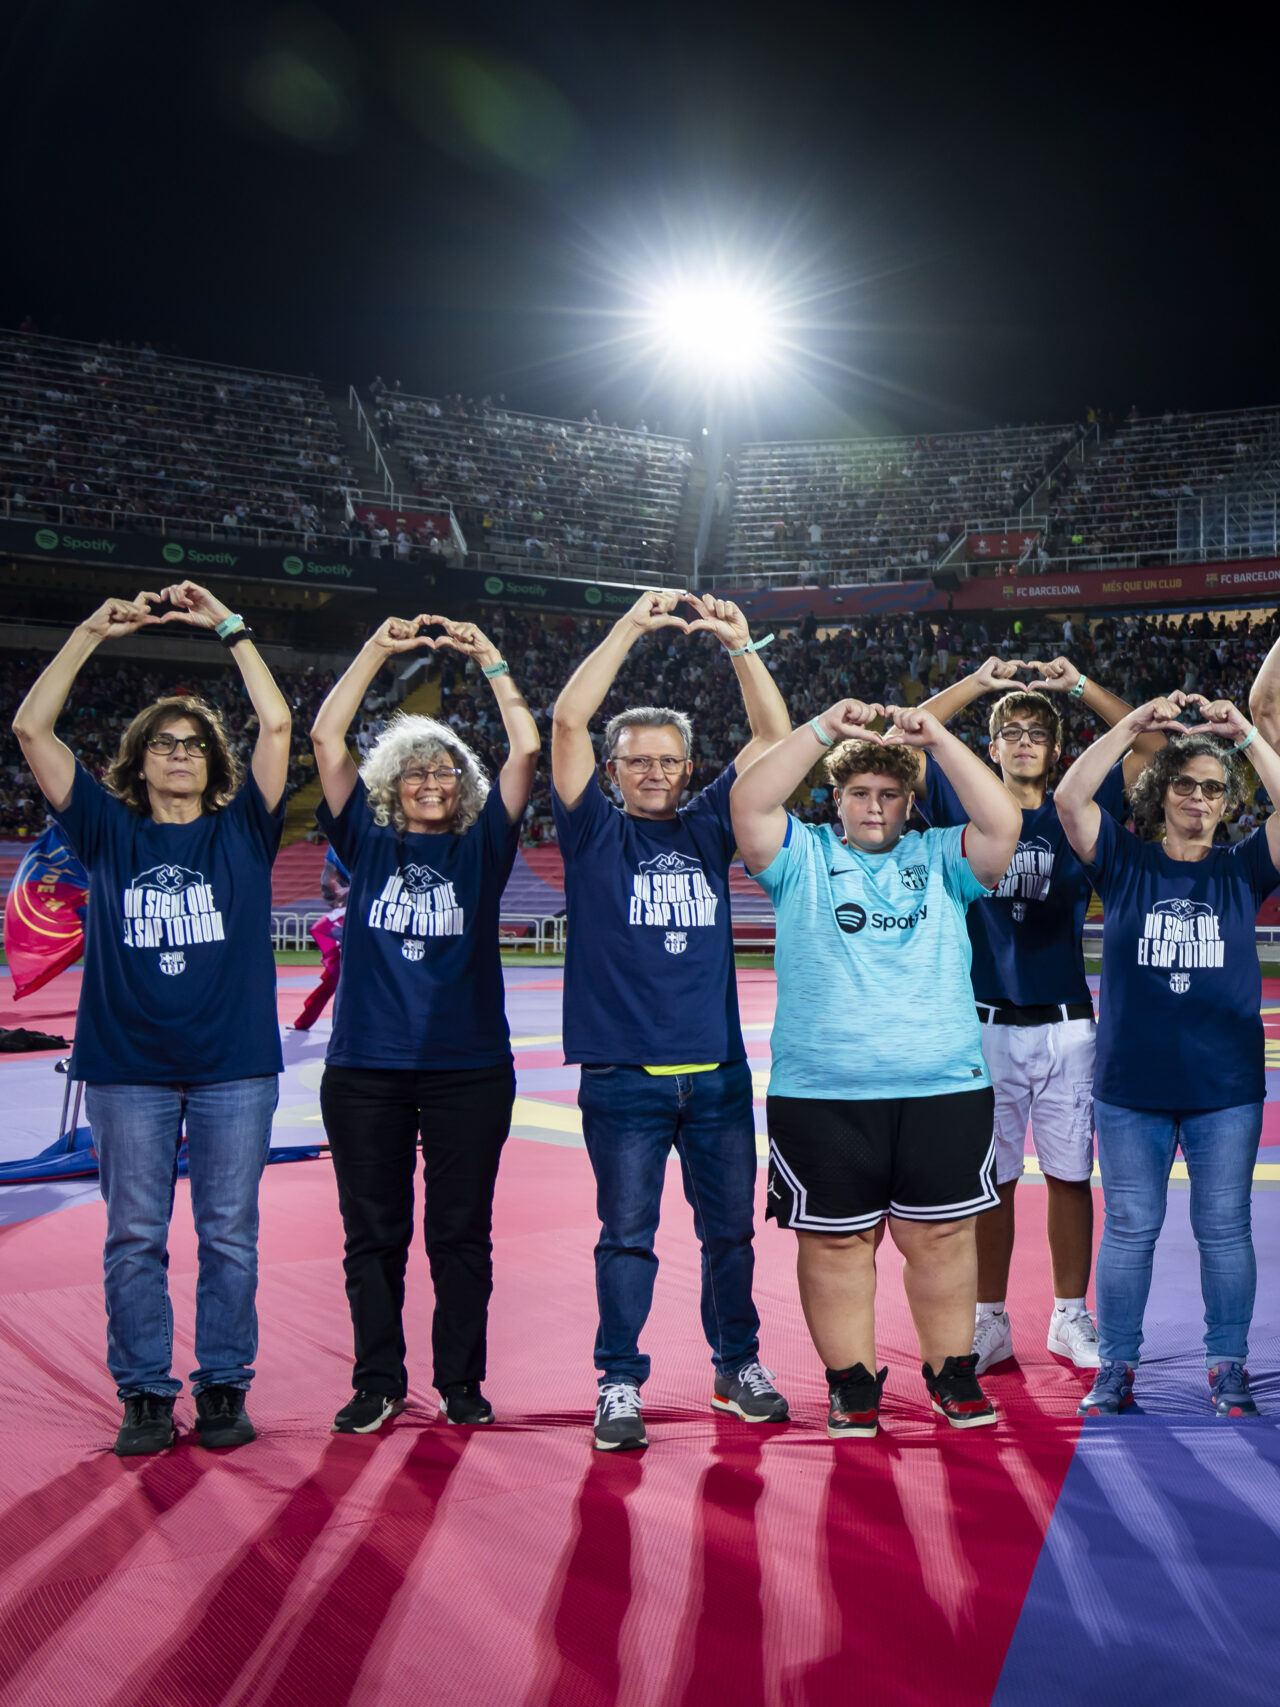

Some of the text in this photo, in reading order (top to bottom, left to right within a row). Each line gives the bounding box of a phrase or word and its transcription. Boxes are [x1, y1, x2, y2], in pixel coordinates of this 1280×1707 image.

[62, 536, 117, 553] Spotify
[187, 550, 239, 568] Spotify
[306, 561, 355, 578] Spotify
[506, 582, 549, 597] Spotify
[1016, 584, 1081, 597] FC BARCELONA
[1102, 578, 1183, 593] MÉS QUE UN CLUB
[1220, 574, 1232, 584] FC
[124, 883, 216, 919] UN SIGNE QUE
[633, 873, 651, 902] UN
[652, 873, 692, 903] SIGNE
[368, 899, 385, 928] EL
[383, 903, 412, 933] SAP
[629, 895, 643, 925] EL
[644, 901, 671, 926] SAP
[871, 904, 928, 932] Spoty
[134, 917, 164, 948] SAP
[164, 911, 225, 946] TOTHOM
[1144, 913, 1221, 944] UN SIGNE QUE
[1137, 938, 1225, 968] EL SAP TOTHOM
